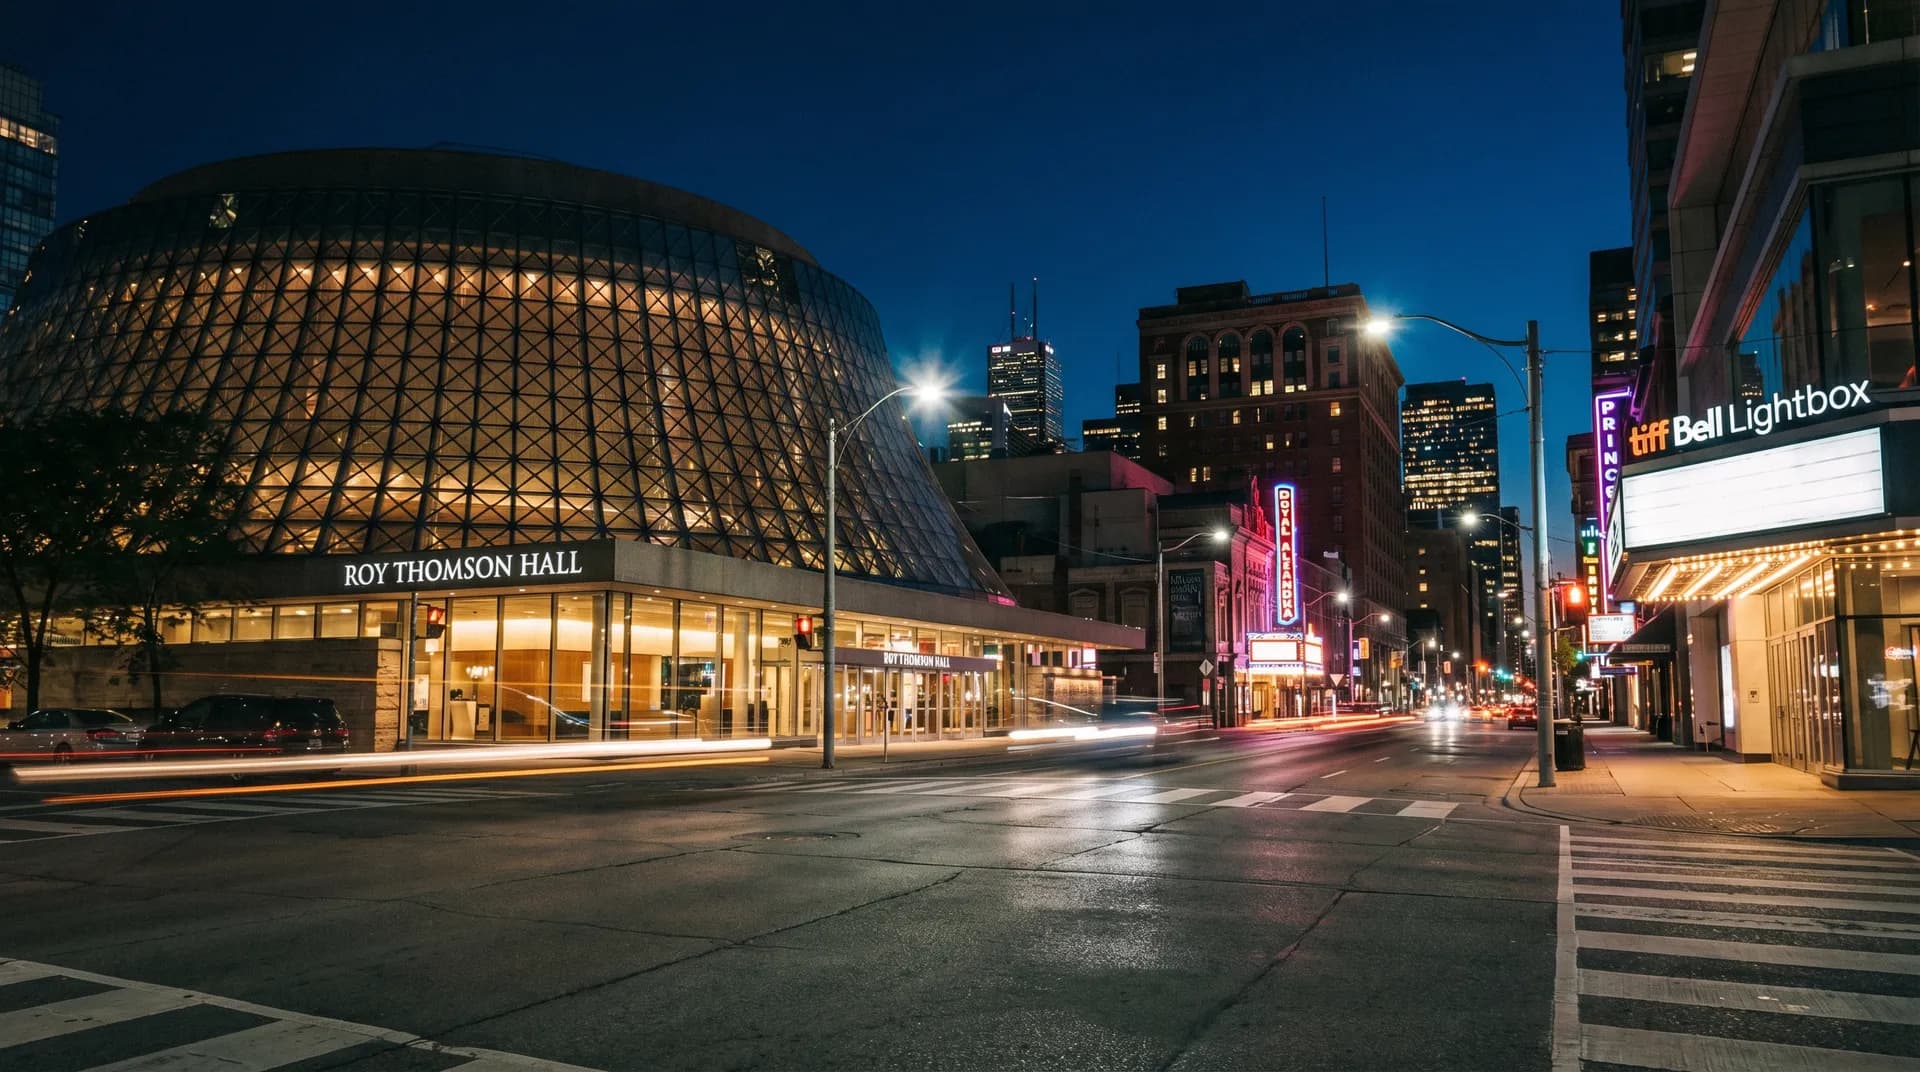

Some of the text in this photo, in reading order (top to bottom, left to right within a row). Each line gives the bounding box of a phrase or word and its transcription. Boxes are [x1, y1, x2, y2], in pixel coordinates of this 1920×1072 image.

[1629, 379, 1871, 456] tiff Bell Lightbox
[344, 550, 583, 586] ROY THOMSON HALL
